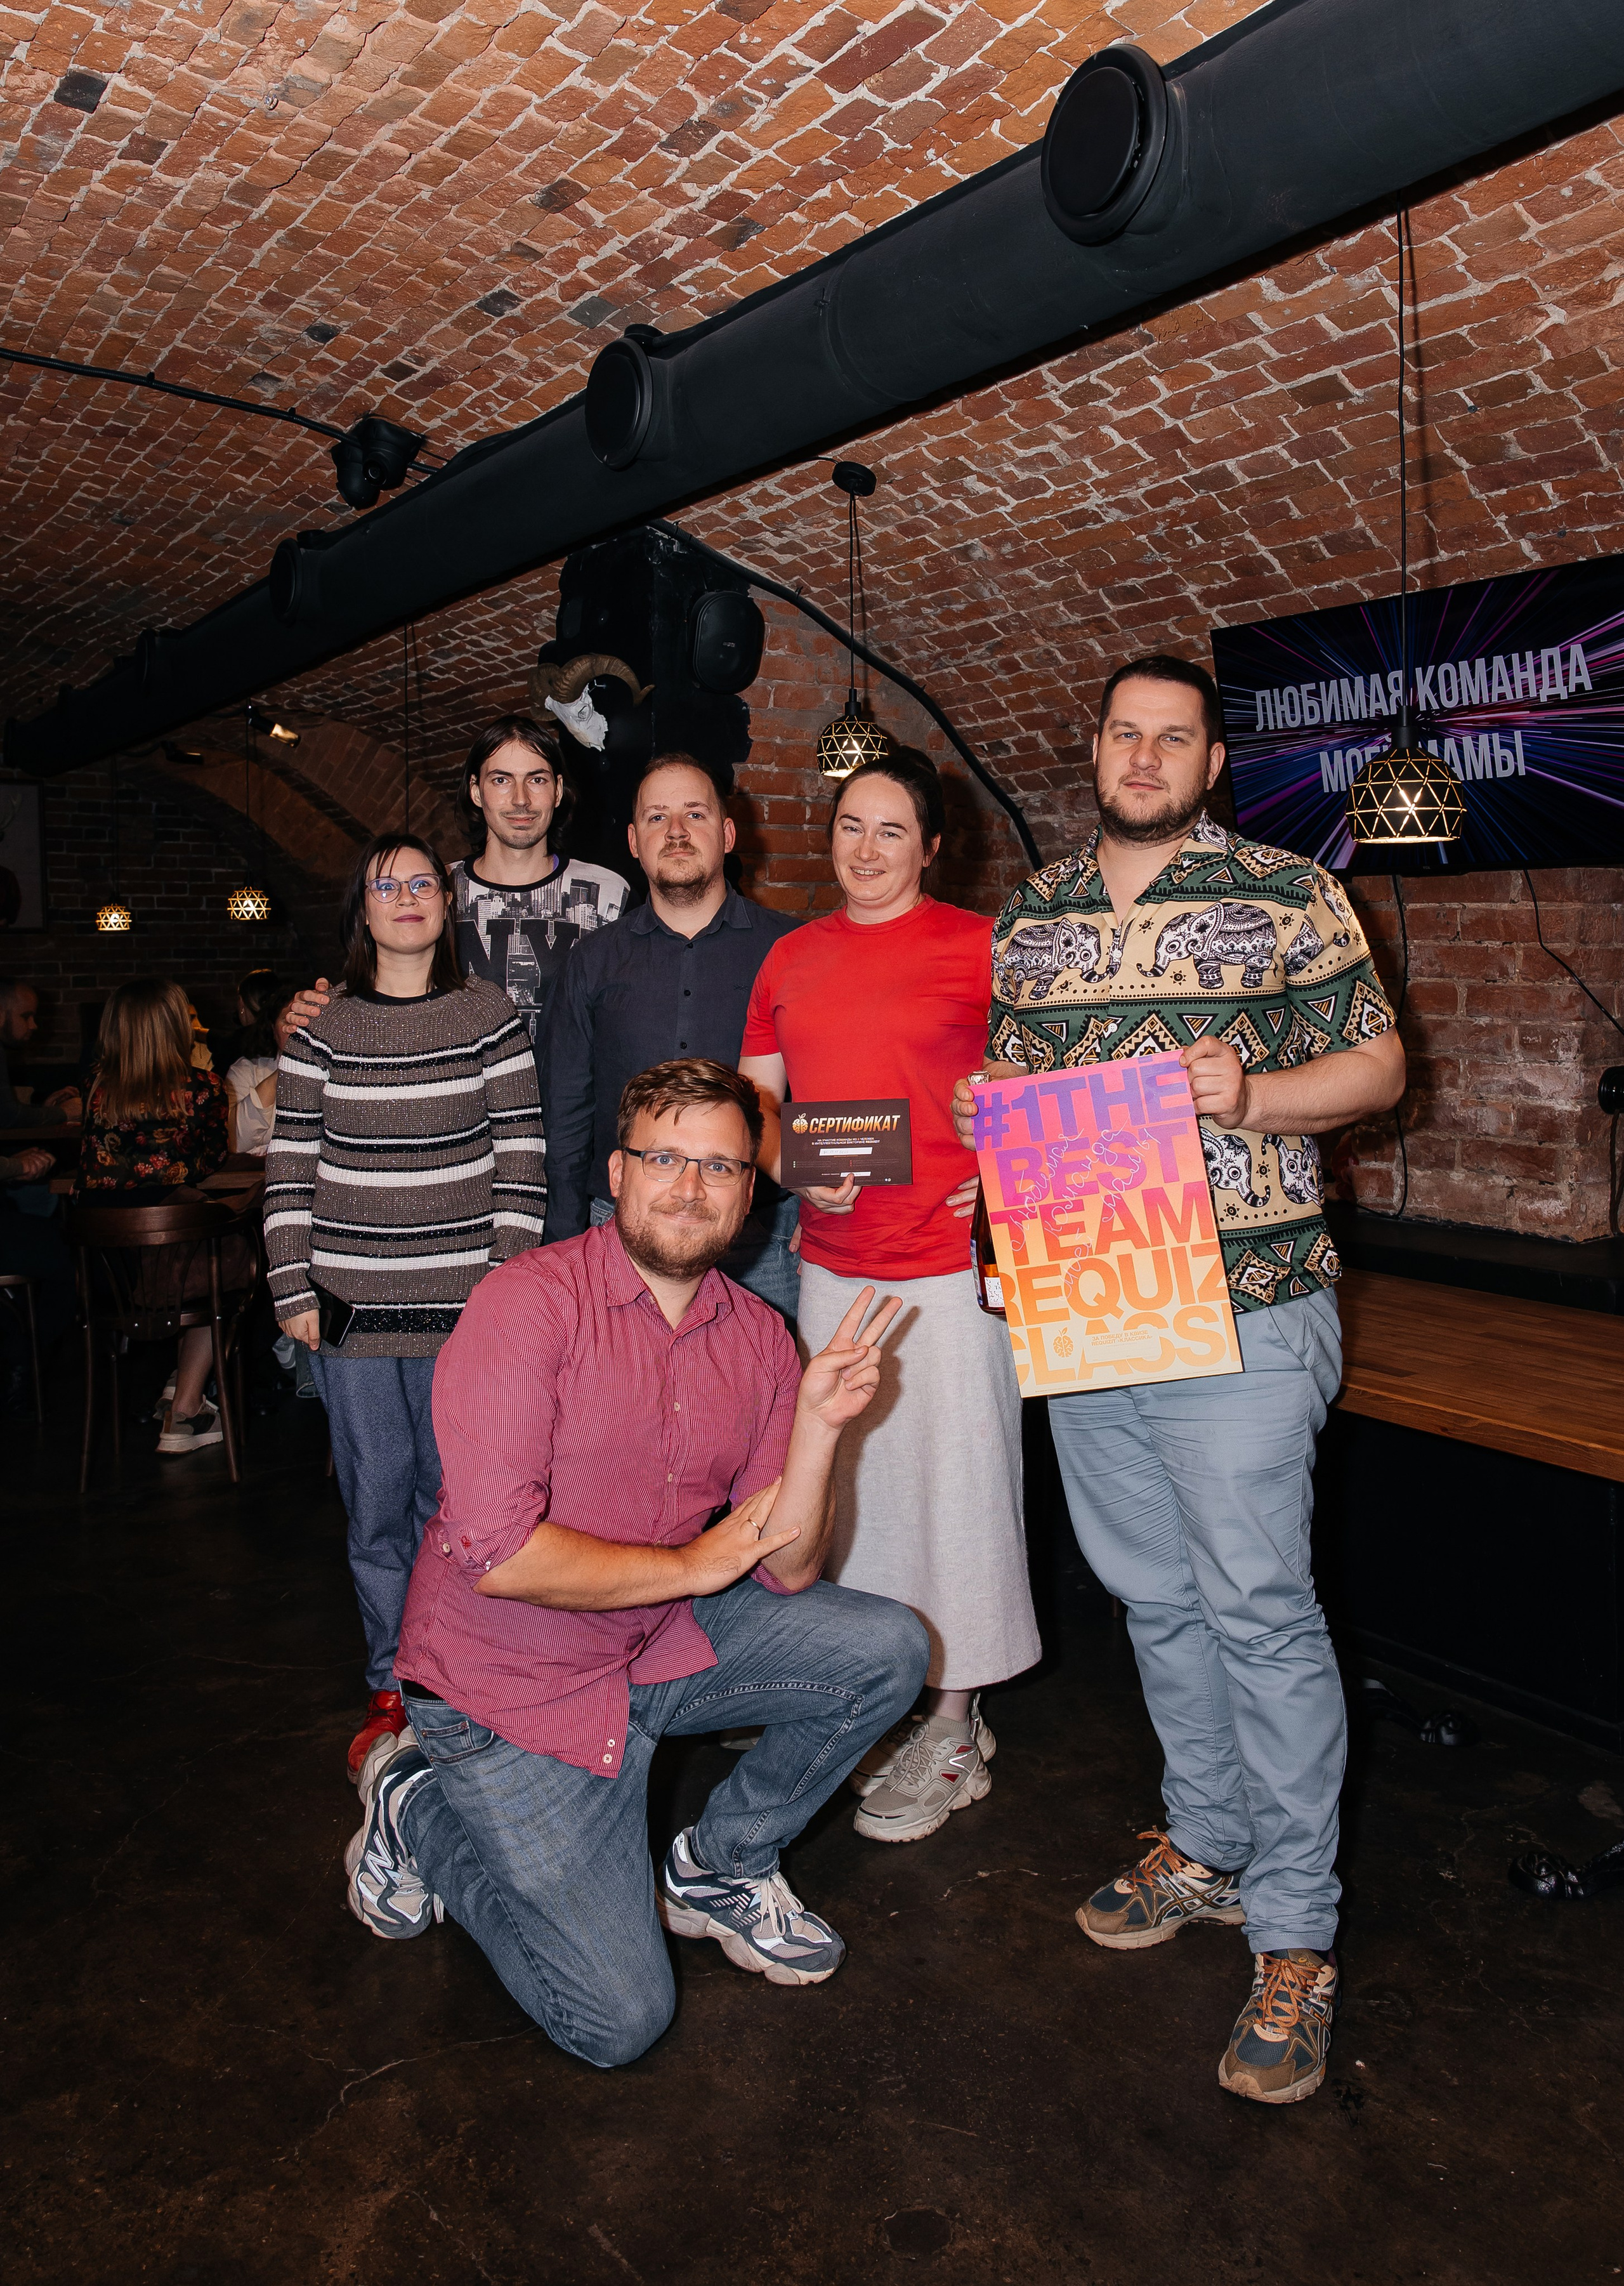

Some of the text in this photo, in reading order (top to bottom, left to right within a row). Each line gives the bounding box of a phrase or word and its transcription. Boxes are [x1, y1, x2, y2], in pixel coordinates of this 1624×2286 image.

[1255, 644, 1593, 732] ЛЮБИМАЯ КОМАНДА
[1418, 731, 1526, 781] АМЫ
[809, 1115, 901, 1134] СЕРТИФИКАТ
[995, 1121, 1188, 1207] BEST
[991, 1181, 1216, 1266] TEAM
